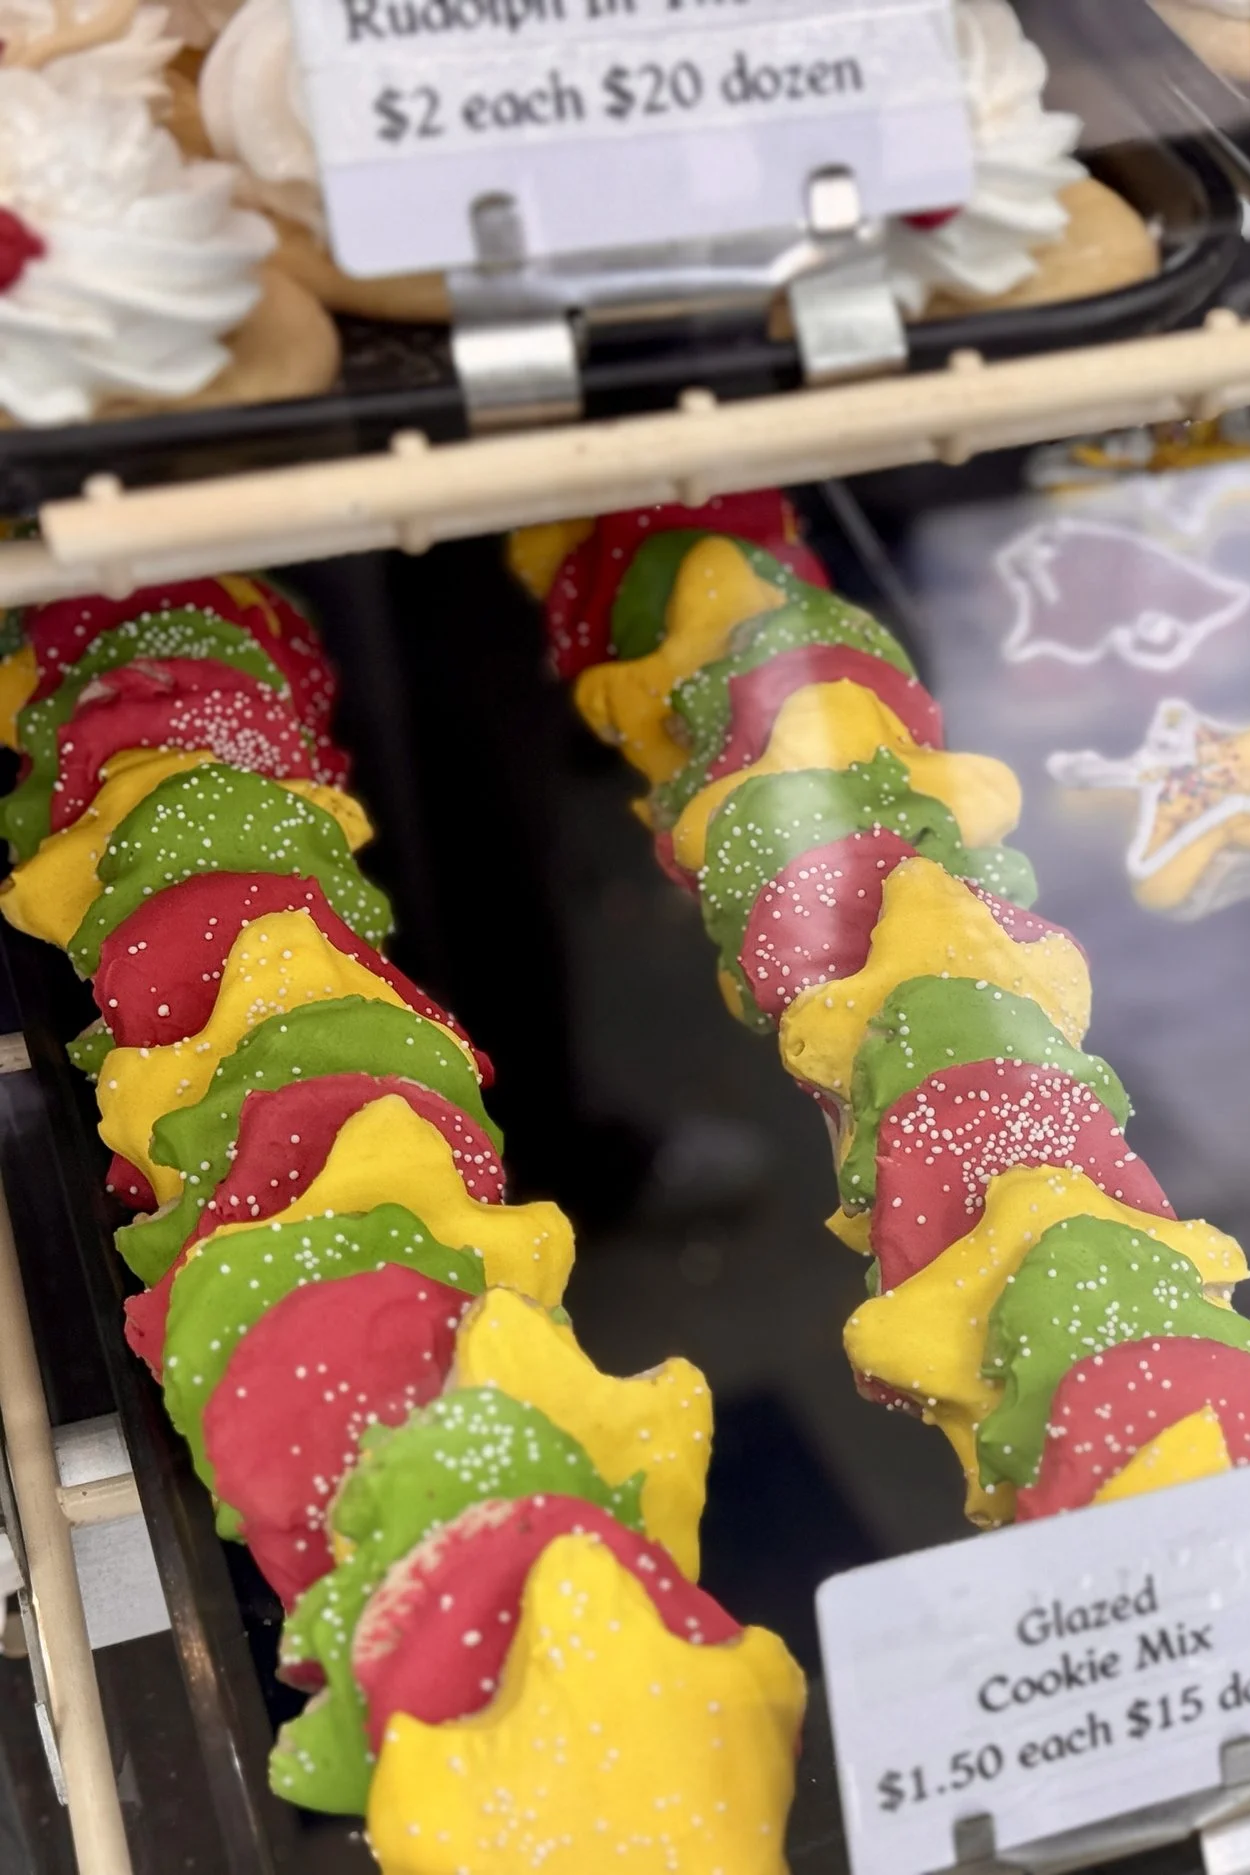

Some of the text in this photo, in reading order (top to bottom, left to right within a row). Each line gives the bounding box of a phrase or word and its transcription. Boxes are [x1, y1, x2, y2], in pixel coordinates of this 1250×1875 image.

[374, 51, 864, 143] $2 each $20 dozen
[1015, 1573, 1159, 1646] Glazed
[977, 1620, 1214, 1714] Cookie Mix
[876, 1743, 1005, 1812] $1.50
[1018, 1712, 1113, 1770] each
[1125, 1685, 1204, 1740] $15
